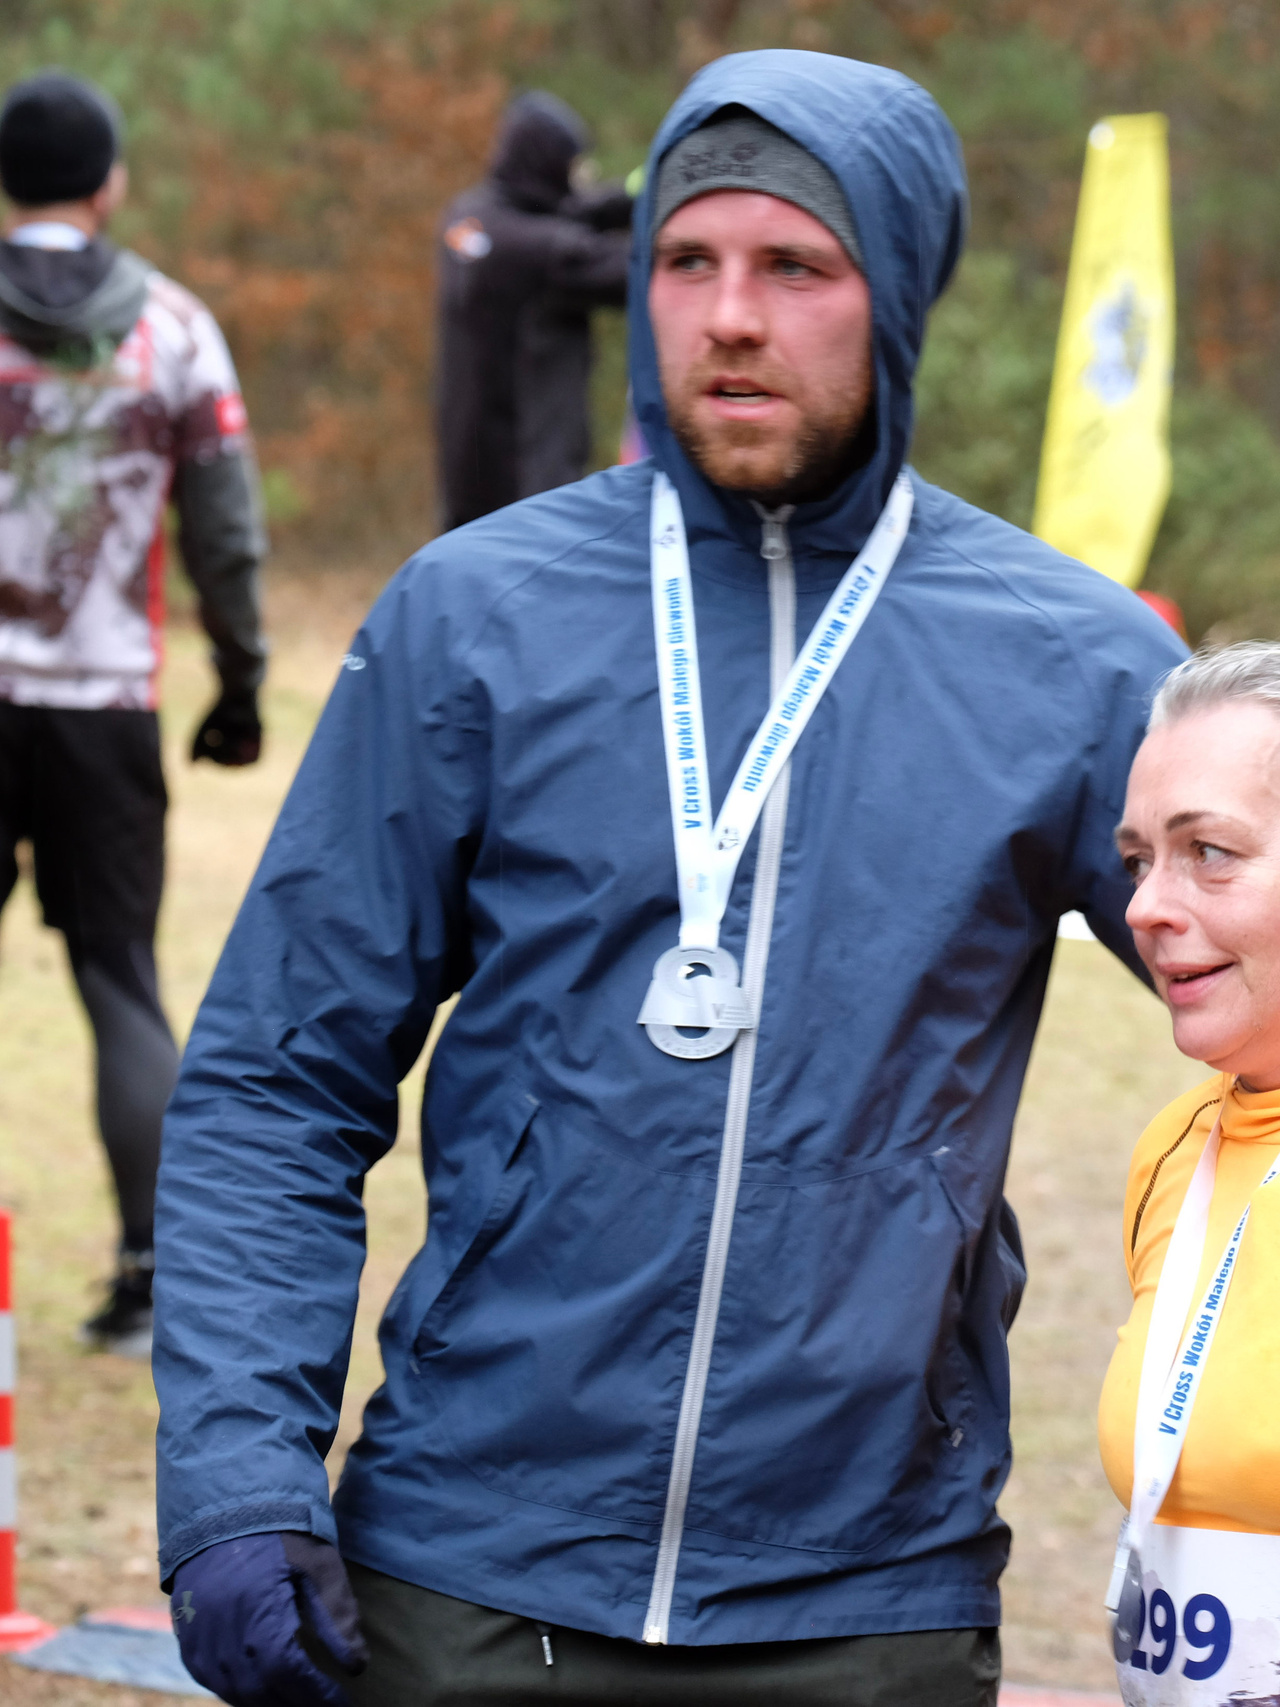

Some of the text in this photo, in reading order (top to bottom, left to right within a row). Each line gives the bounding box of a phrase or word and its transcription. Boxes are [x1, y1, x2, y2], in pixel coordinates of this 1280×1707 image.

[838, 576, 870, 617] Cross
[682, 766, 701, 814] Cross
[1158, 1248, 1235, 1436] V Cross Wokół Małego
